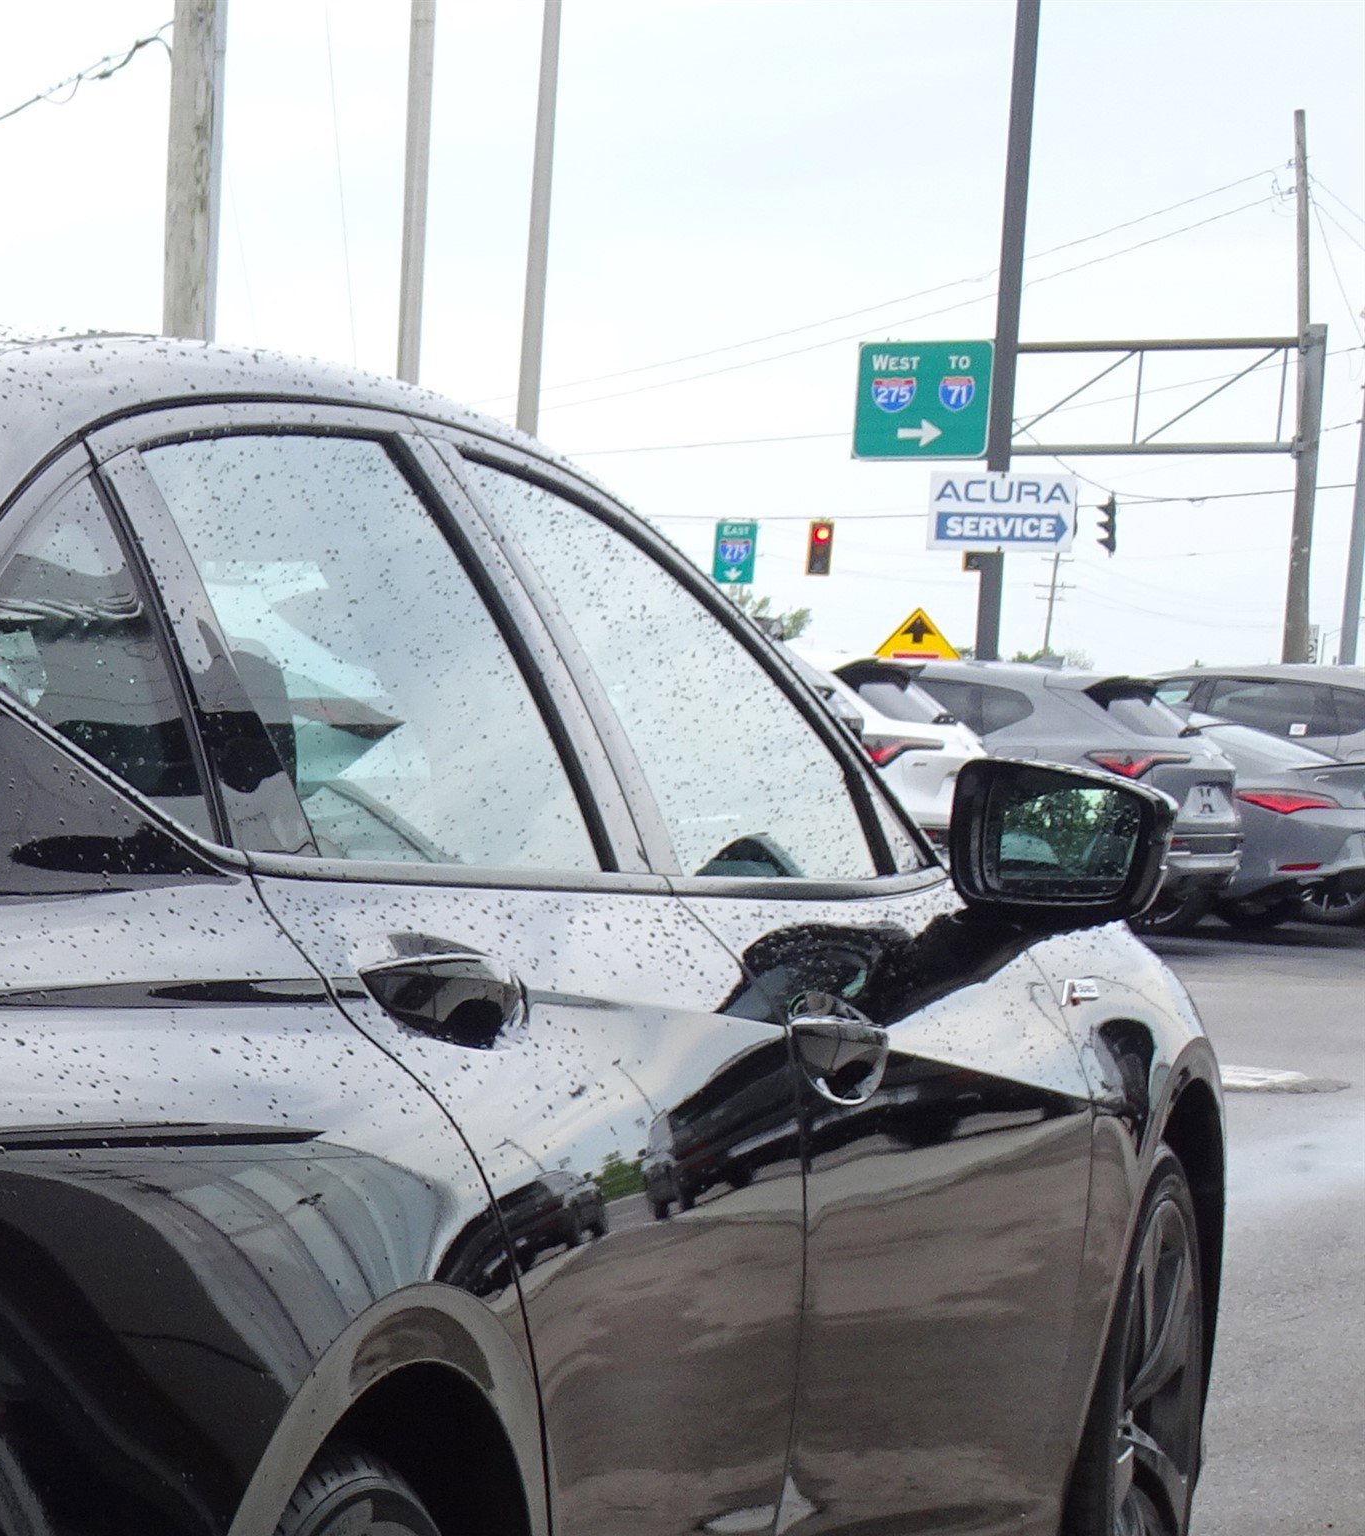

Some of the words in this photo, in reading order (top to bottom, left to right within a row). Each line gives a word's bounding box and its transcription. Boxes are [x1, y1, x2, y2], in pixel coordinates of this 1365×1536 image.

[872, 354, 920, 371] WEST
[949, 355, 971, 370] TO
[876, 386, 910, 403] 275
[947, 385, 967, 405] 71
[934, 480, 1071, 504] ACURA
[945, 515, 1057, 539] SERVICE
[725, 544, 748, 560] 275
